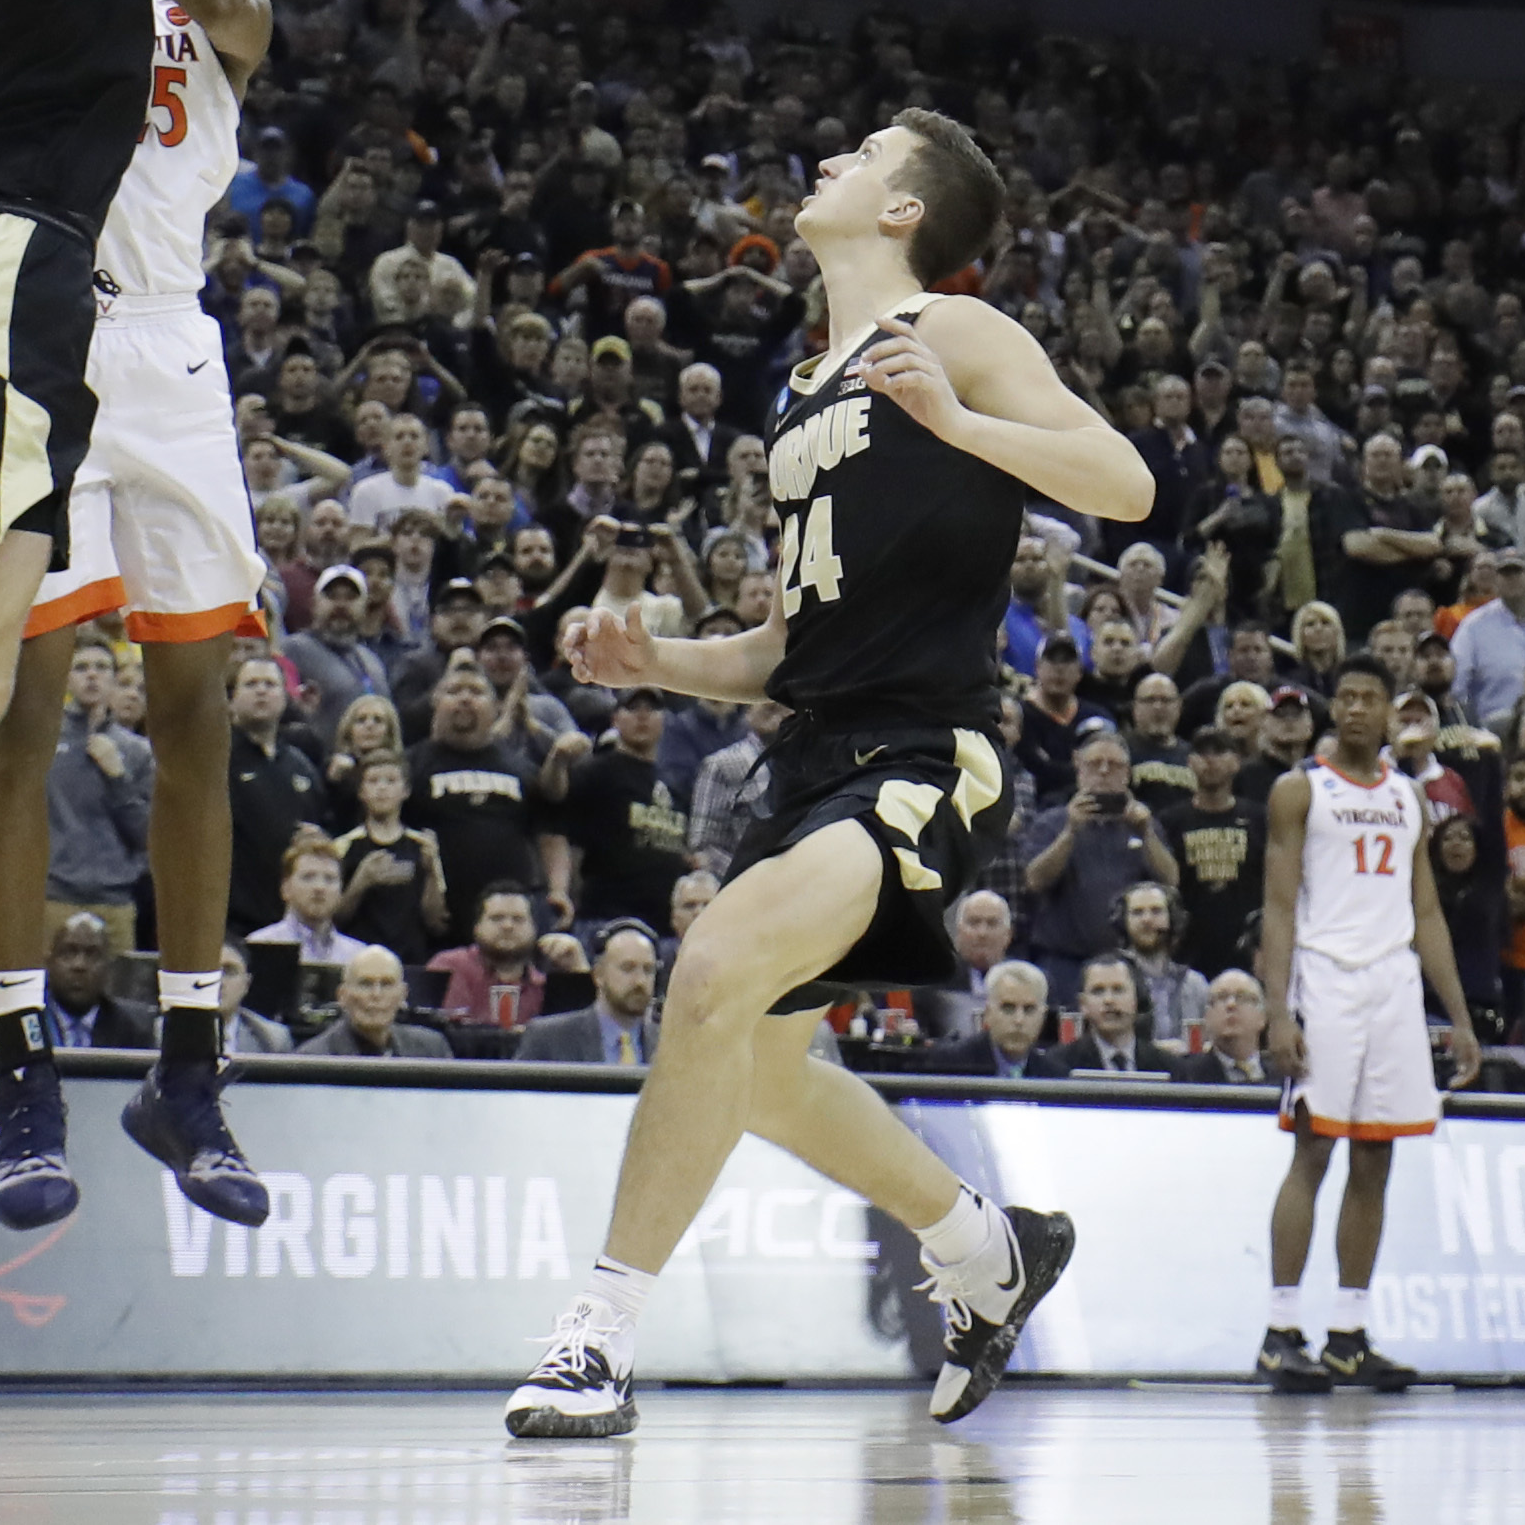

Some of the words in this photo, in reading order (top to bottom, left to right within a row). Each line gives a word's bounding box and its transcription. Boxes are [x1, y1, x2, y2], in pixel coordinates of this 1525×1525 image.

[135, 65, 187, 147] 5
[769, 395, 872, 502] URDUE
[780, 494, 845, 620] 24
[1331, 808, 1409, 828] VIRGINIA
[1352, 833, 1396, 876] 12
[672, 1187, 882, 1259] ACC
